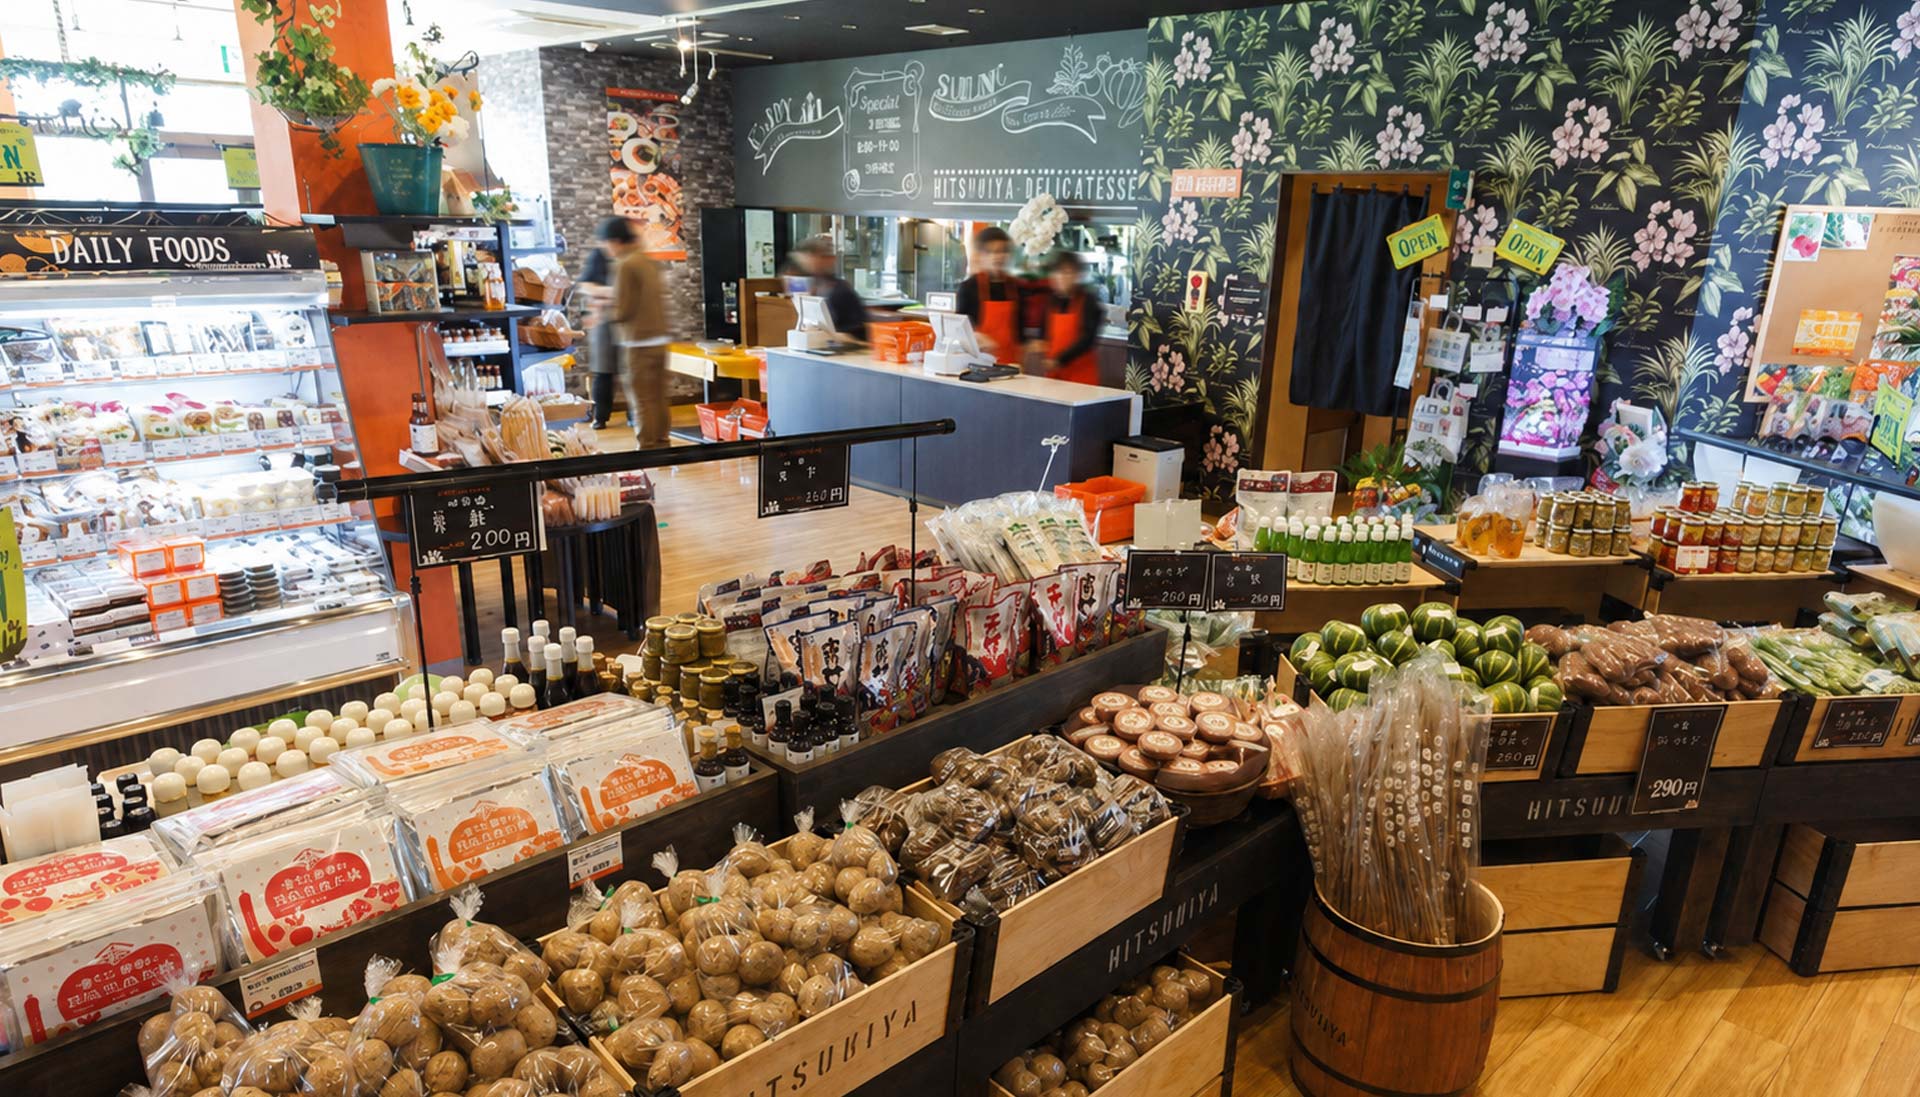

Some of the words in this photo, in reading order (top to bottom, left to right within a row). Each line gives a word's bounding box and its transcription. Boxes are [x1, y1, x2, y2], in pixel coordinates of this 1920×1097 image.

[859, 95, 900, 115] Special
[50, 236, 133, 264] DAILY
[147, 236, 230, 263] FOODS
[1398, 229, 1438, 258] OPEN
[1508, 233, 1549, 265] OPEN
[806, 487, 843, 503] 260円
[470, 528, 530, 550] 200円
[1161, 591, 1201, 606] 260円
[1496, 751, 1537, 766] 260円
[1650, 778, 1698, 798] 290円
